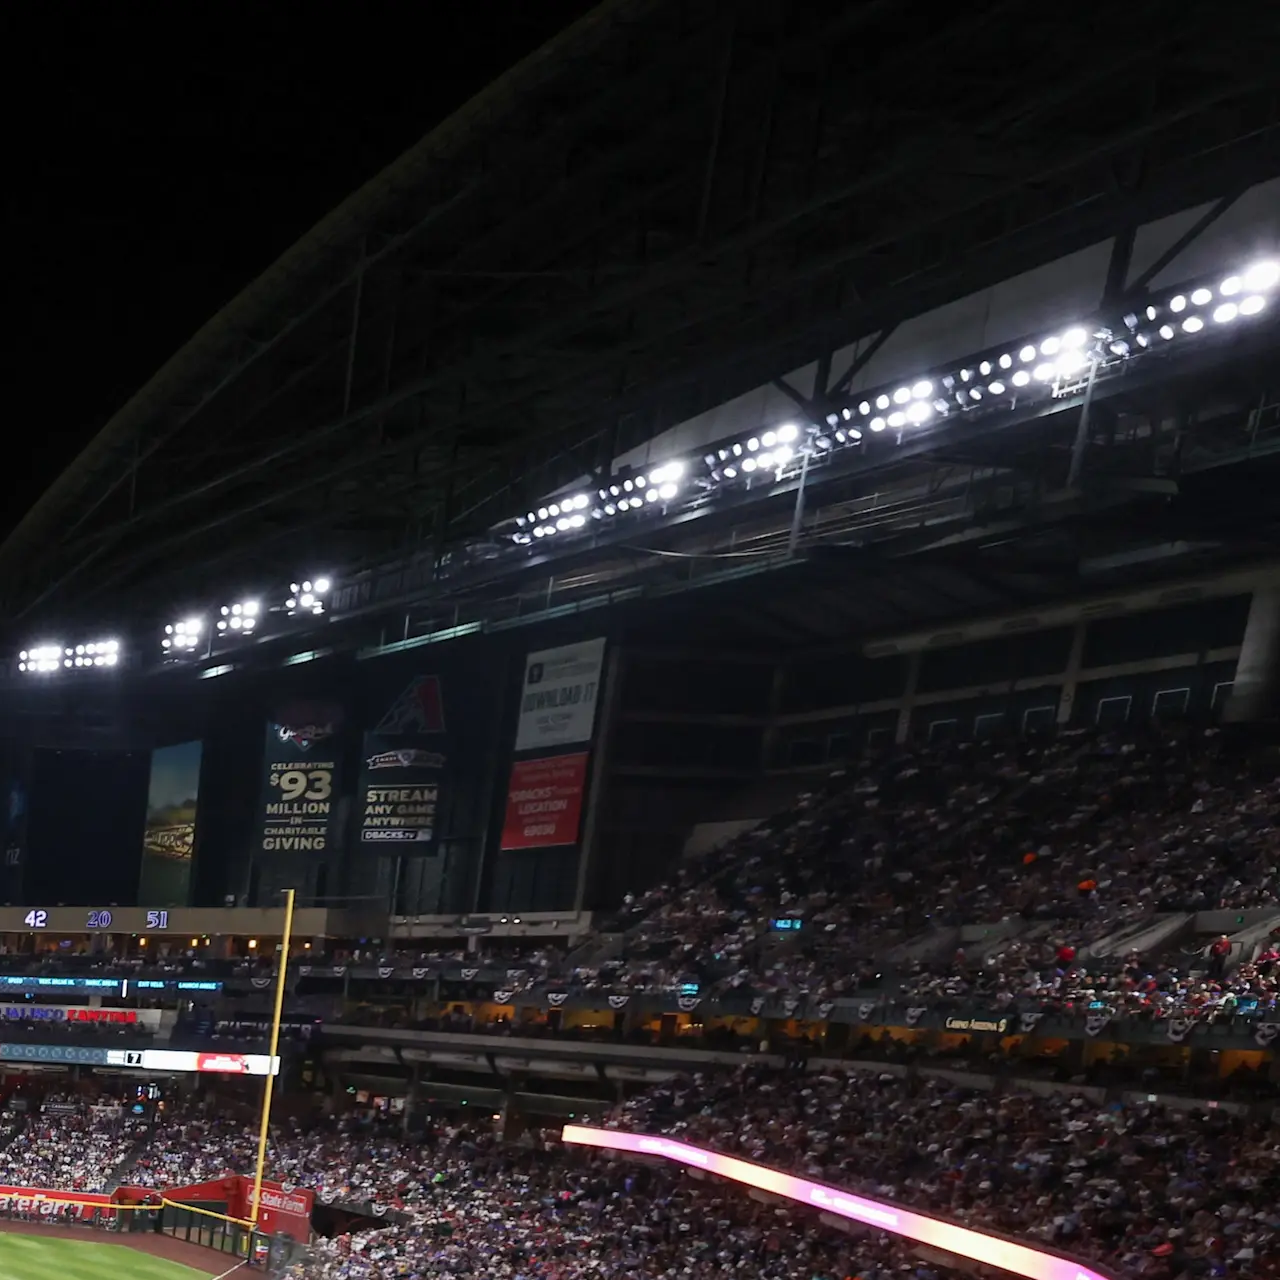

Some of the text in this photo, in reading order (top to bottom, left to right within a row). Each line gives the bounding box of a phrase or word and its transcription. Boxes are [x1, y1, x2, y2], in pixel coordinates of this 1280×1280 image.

[271, 762, 335, 770] CELEBRATING
[269, 770, 332, 800] $93
[366, 790, 438, 802] STREAM
[266, 802, 330, 814] MILLION
[365, 804, 435, 814] ANY GAME
[518, 800, 568, 815] LOCATION
[363, 817, 433, 826] ANYWHERE
[264, 827, 327, 835] CHARITABLE
[262, 837, 326, 850] GIVING
[25, 910, 168, 928] 42 20 51
[5, 1006, 64, 1020] JALISCO
